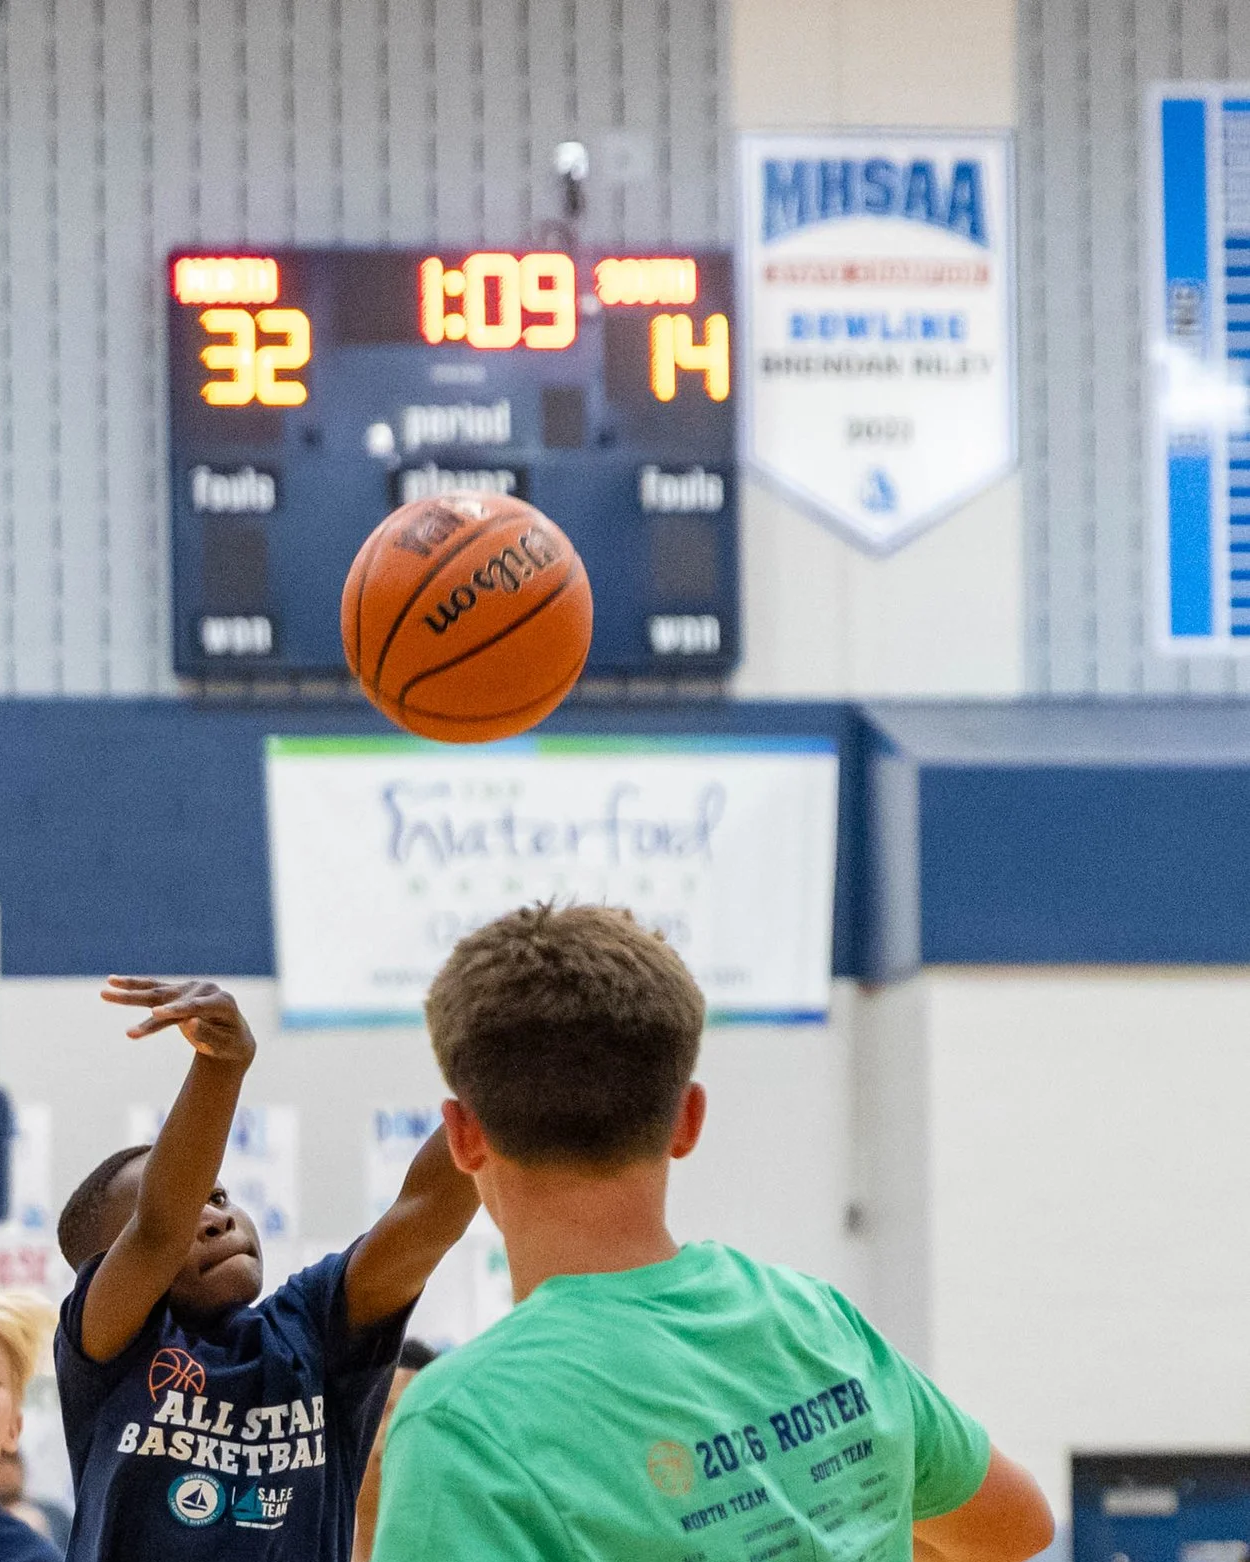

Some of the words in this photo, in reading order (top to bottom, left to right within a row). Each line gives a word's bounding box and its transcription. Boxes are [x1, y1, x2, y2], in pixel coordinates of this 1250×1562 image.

[762, 157, 990, 250] MHSAA
[421, 253, 576, 350] 1:09
[200, 308, 311, 406] 32
[650, 313, 730, 402] 14
[403, 401, 511, 450] period
[193, 466, 276, 512] fouls
[641, 464, 724, 512] fouls
[423, 526, 562, 637] Wilson
[153, 1390, 234, 1436] ALL
[241, 1395, 326, 1441] STAR
[769, 1377, 872, 1453] ROSTER
[117, 1422, 327, 1476] BASKETBAL
[810, 1454, 844, 1484] SOUTH
[842, 1438, 874, 1466] TEAM
[261, 1502, 288, 1518] TEAM
[680, 1502, 729, 1532] NORTH
[729, 1486, 770, 1514] TEAM
